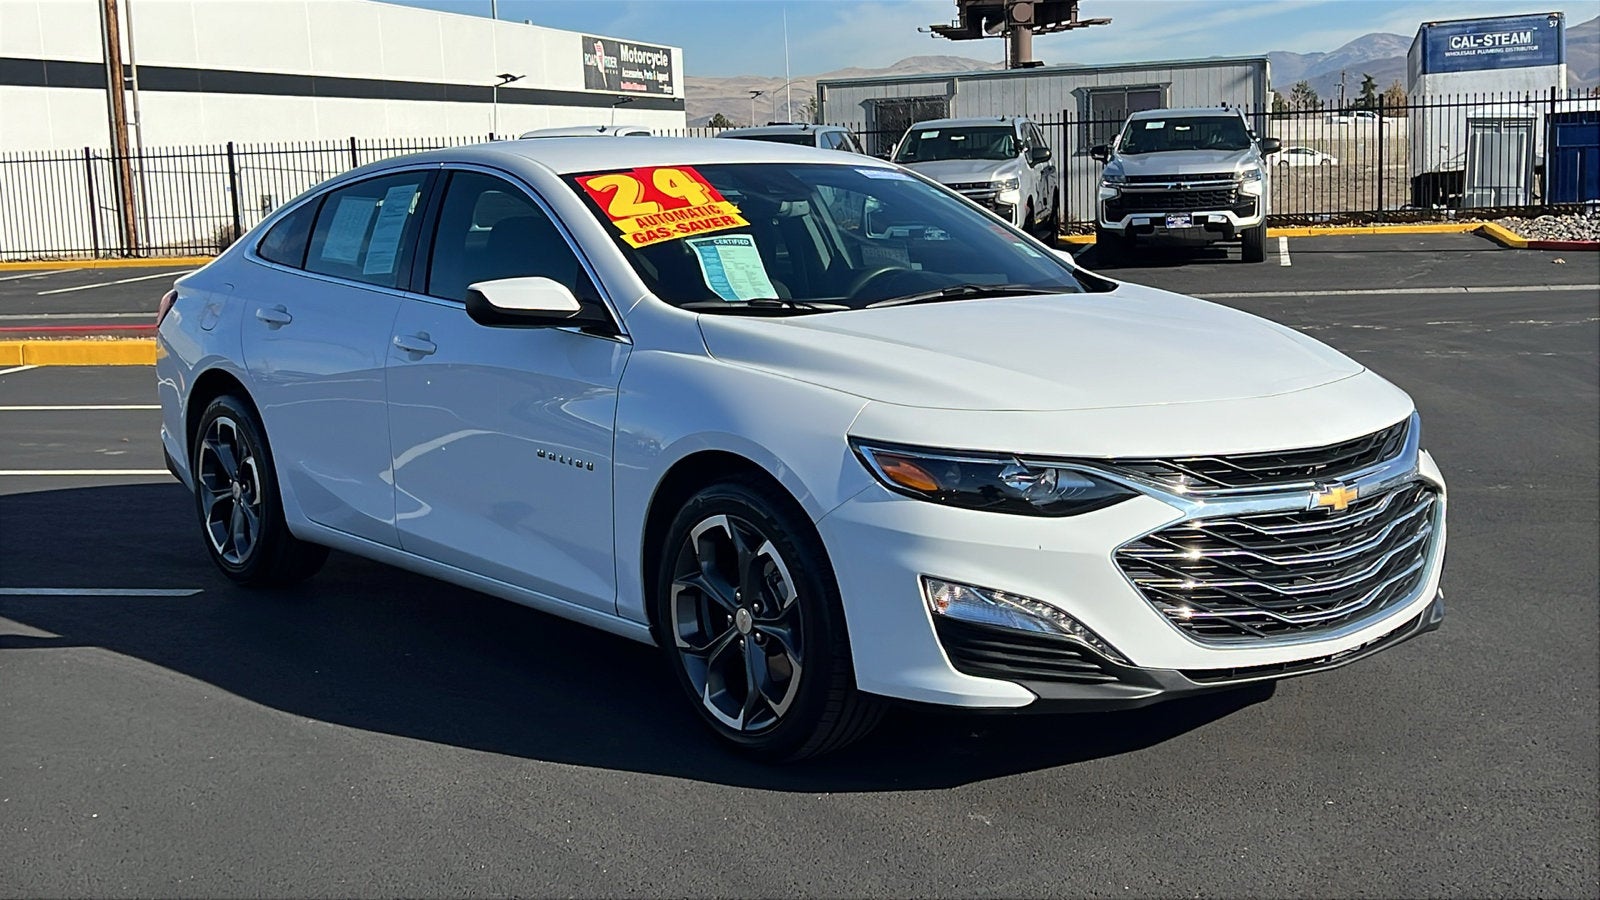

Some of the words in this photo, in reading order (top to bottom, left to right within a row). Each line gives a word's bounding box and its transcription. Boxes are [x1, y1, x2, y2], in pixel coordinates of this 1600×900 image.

[1549, 20, 1558, 28] 57
[1451, 32, 1531, 48] CAL-STEAM
[1477, 47, 1504, 55] PLUMBING
[1505, 45, 1538, 53] DISTRIBUTOR
[620, 44, 668, 68] Motorcycle
[586, 168, 710, 218] 24
[635, 204, 723, 229] AUTOMATIC
[631, 215, 736, 245] GAS-SAVER
